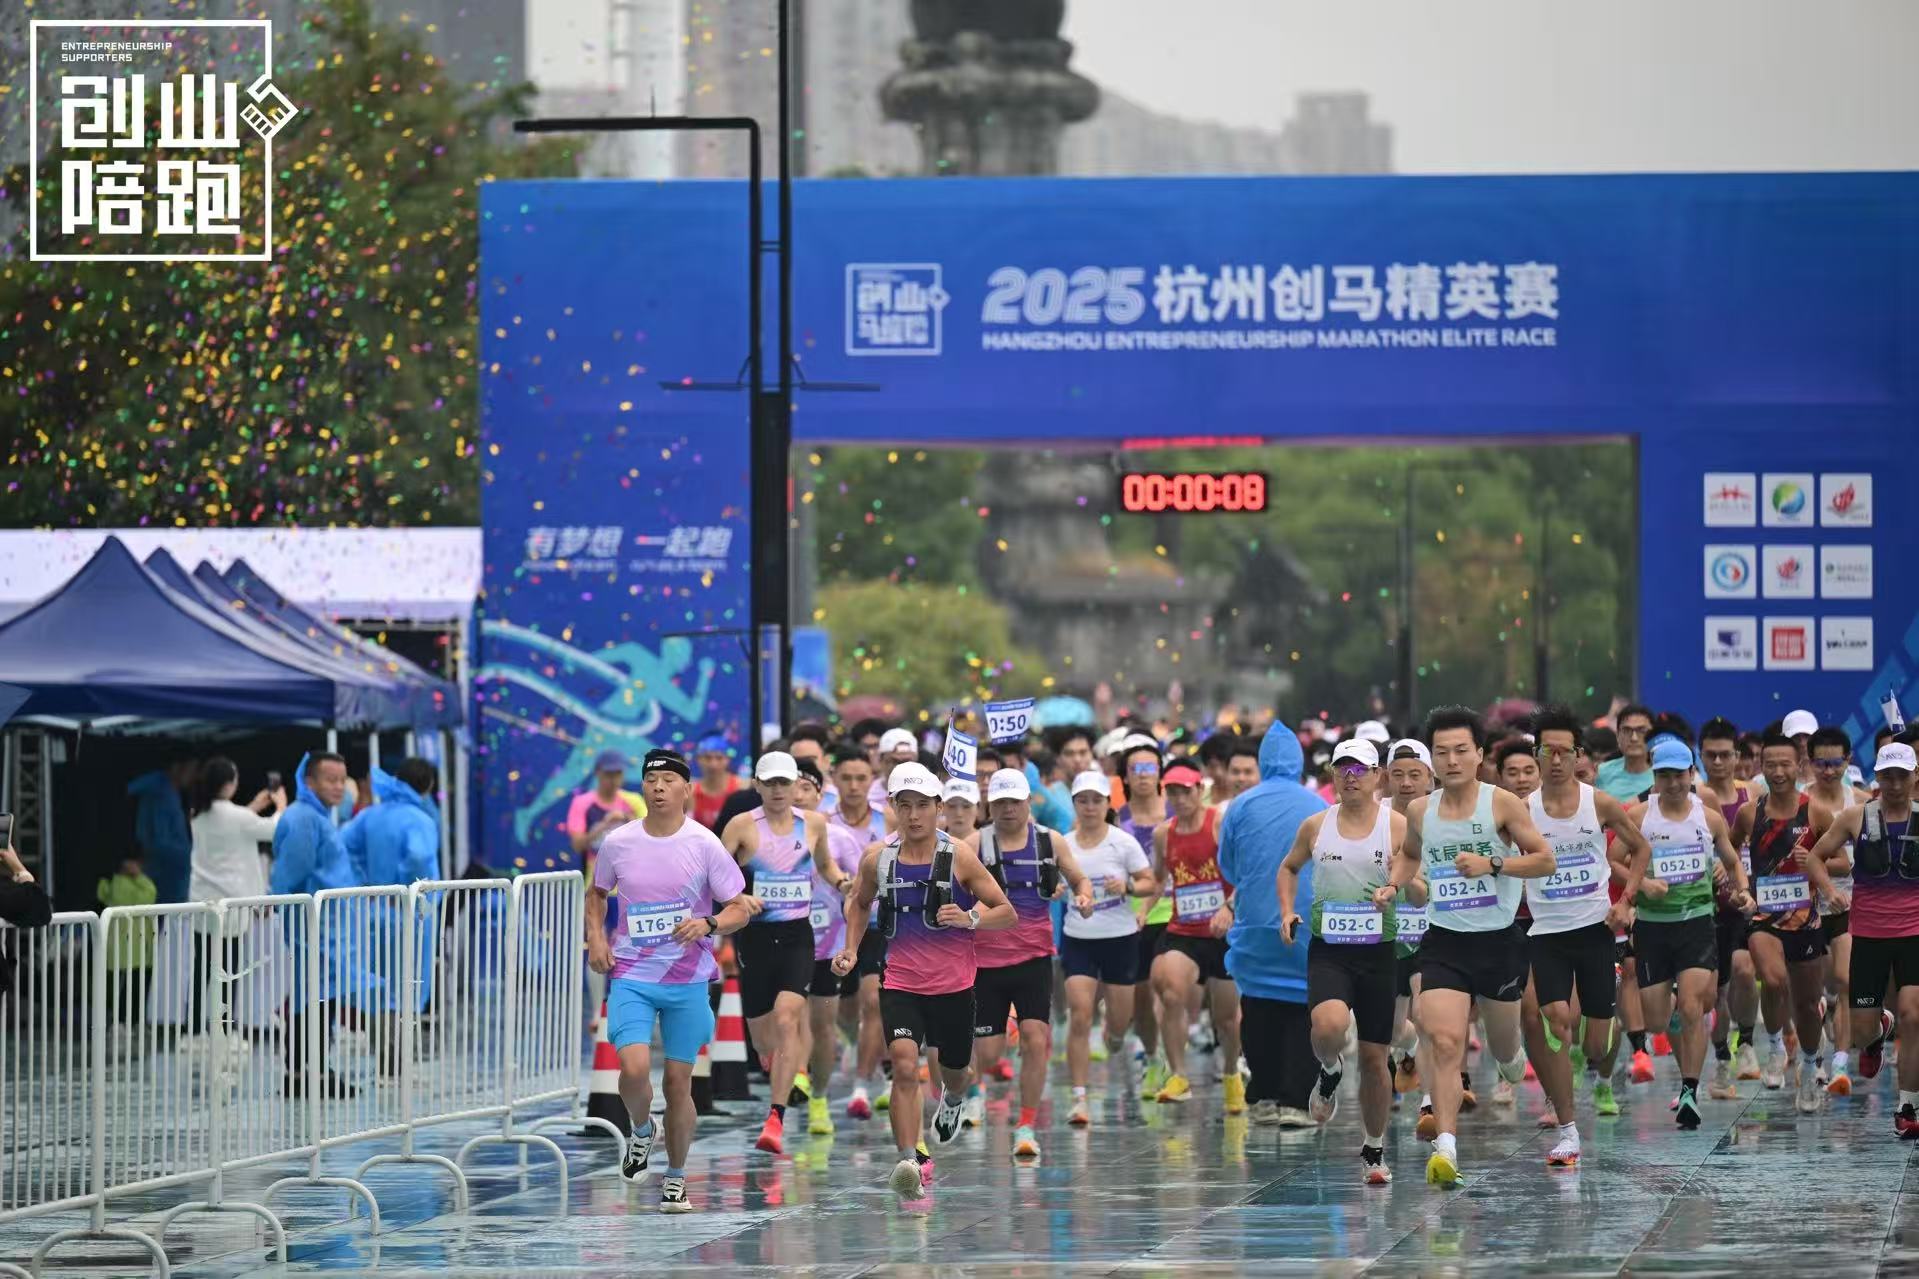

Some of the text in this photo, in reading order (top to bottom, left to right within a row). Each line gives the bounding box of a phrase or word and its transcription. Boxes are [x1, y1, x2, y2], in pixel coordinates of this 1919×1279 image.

[981, 327, 1557, 351] HANGZHOU ENTREPRENEURSHIP MARATHON ELITE RACE
[1123, 473, 1265, 512] 00:00:08
[1660, 858, 1701, 873] 052-D
[1545, 870, 1590, 886] 254-D
[760, 885, 804, 898] 268-A
[1439, 880, 1488, 897] 052-A
[1763, 887, 1803, 901] 194-B
[1328, 917, 1375, 932] 052-C
